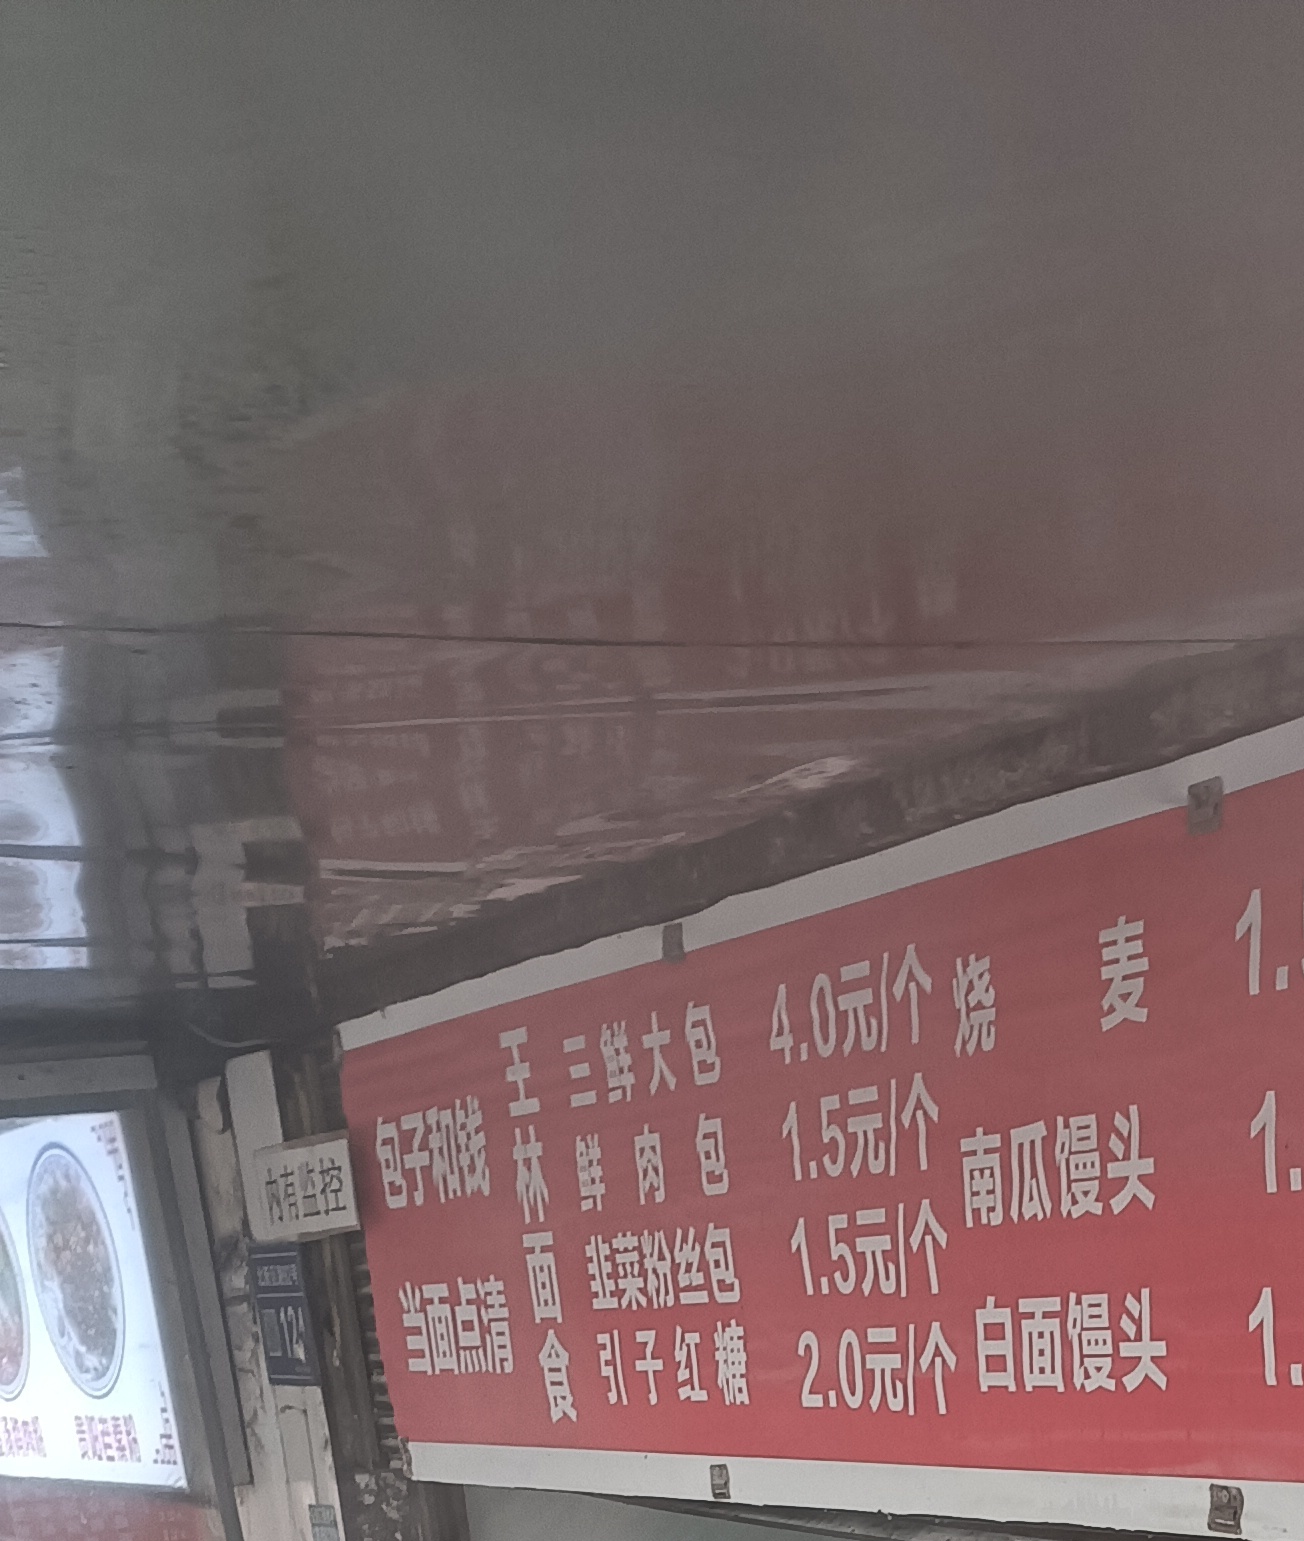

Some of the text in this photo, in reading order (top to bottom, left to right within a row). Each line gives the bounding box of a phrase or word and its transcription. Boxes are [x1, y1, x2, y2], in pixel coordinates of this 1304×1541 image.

[769, 943, 932, 1065] 4.0元/个
[952, 914, 1150, 1058] 烧麦
[562, 1001, 721, 1108] 三鲜大包
[376, 1095, 490, 1209] 包子和钱
[575, 1113, 730, 1212] 鲜肉包
[782, 1072, 939, 1181] 1.5元/个
[959, 1104, 1156, 1229] 南瓜馒头
[499, 1027, 577, 1424] 王林面食
[585, 1222, 741, 1311] 韭菜粉丝包
[790, 1198, 948, 1298] 1.5元/个
[398, 1274, 514, 1376] 当面点清
[596, 1318, 750, 1406] 引子红糖
[797, 1321, 957, 1416] 2.0元/个
[974, 1287, 1168, 1394] 白面馒头
